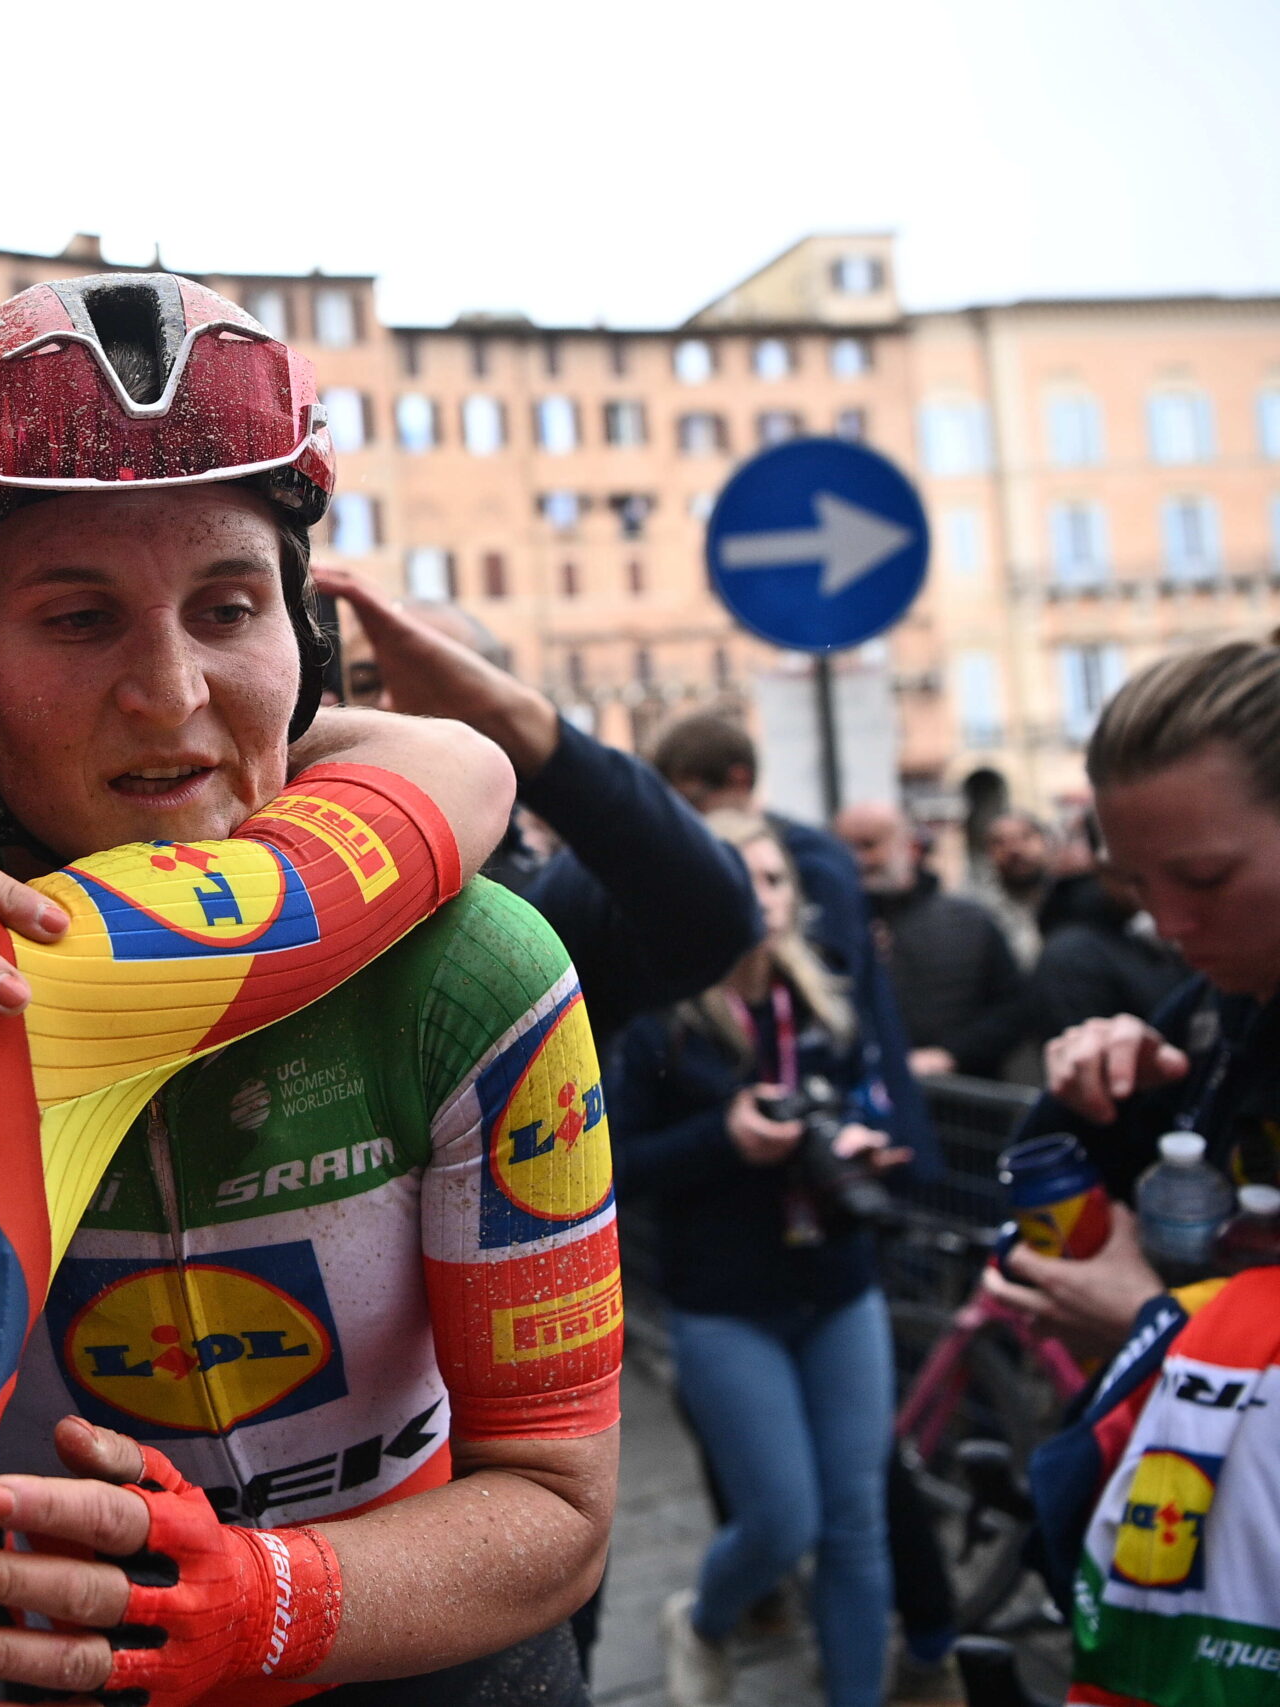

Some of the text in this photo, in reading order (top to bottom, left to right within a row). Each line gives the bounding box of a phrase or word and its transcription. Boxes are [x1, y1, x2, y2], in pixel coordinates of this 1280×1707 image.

[276, 1057, 307, 1081] UCI
[280, 1063, 347, 1099] WOMEN'S
[282, 1078, 366, 1118] WORLDTEAM
[215, 1137, 395, 1208] SRAM
